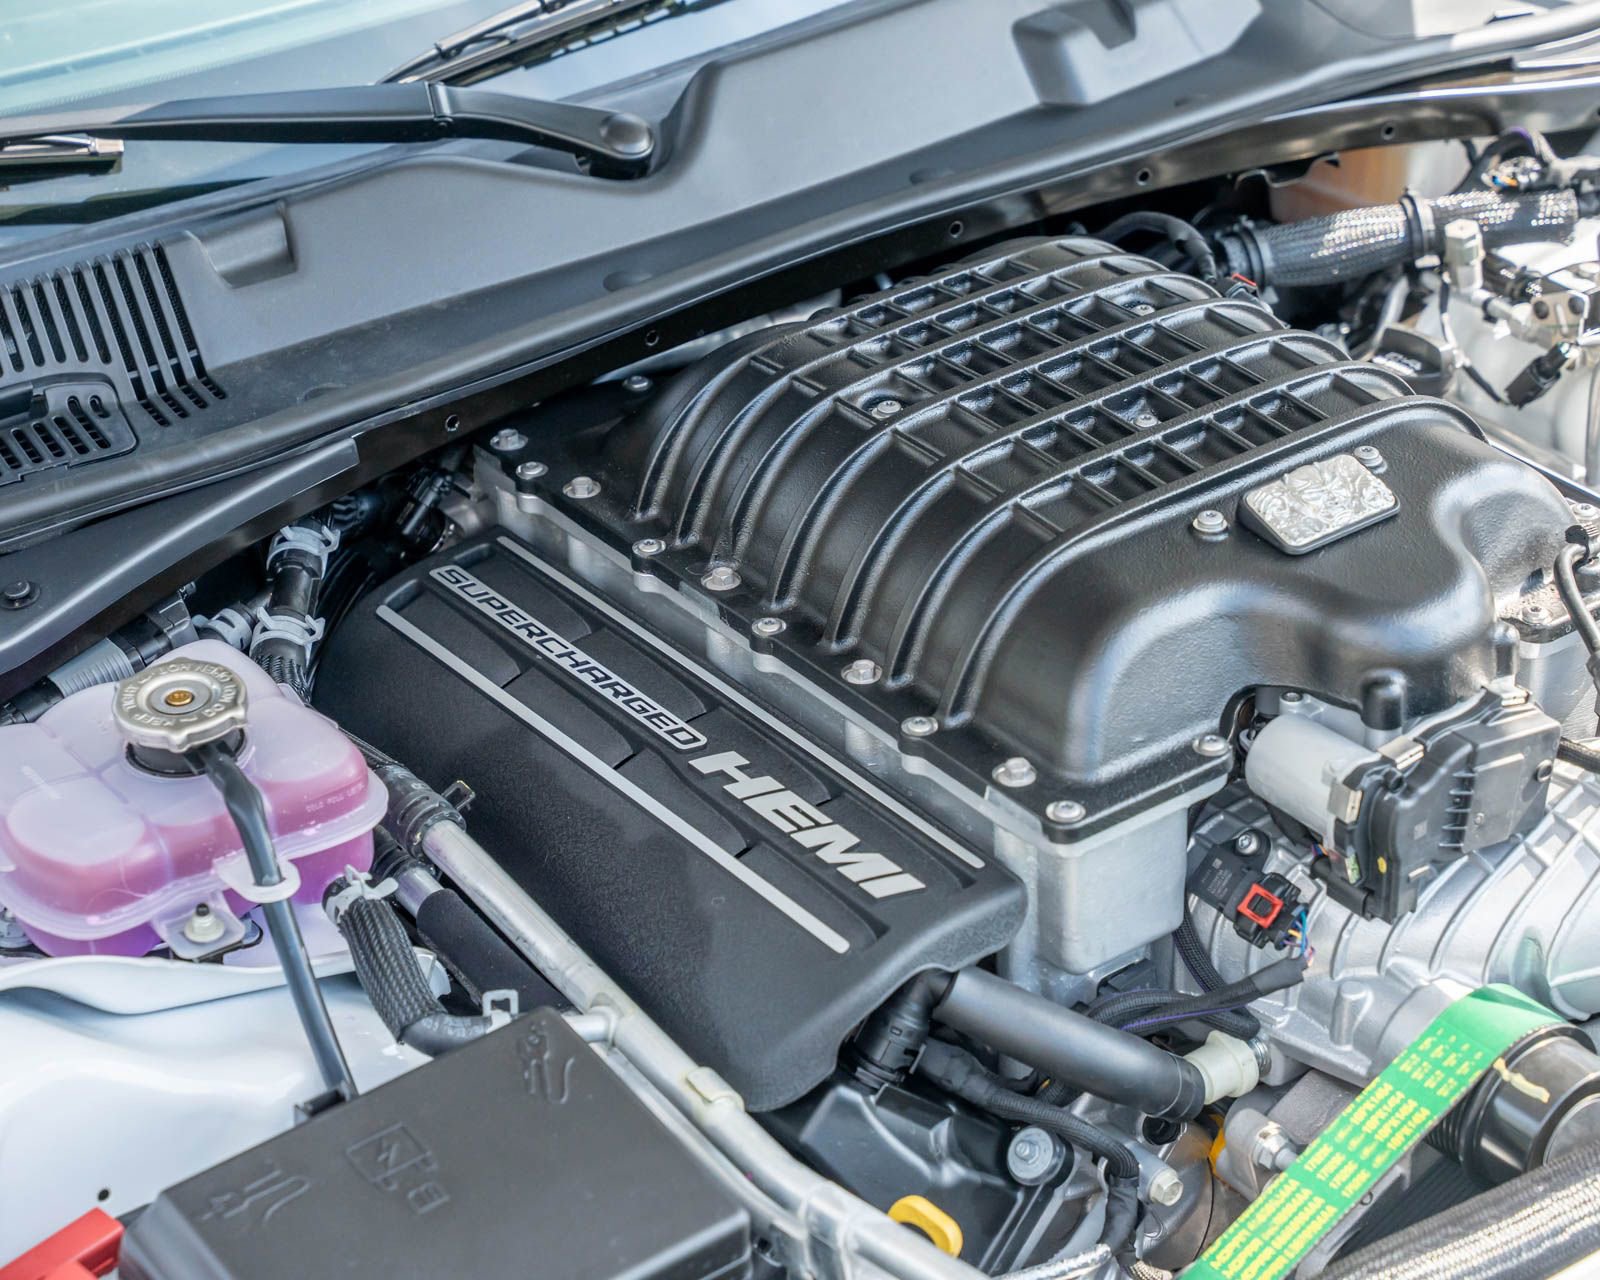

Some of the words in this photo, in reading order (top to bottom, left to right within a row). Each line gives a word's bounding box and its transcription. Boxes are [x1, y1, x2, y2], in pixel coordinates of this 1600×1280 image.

[195, 664, 233, 682] OPEN
[202, 703, 225, 717] DO
[133, 713, 177, 727] KEEP
[436, 568, 702, 748] SUPERCHARGED
[688, 751, 926, 899] HEMI
